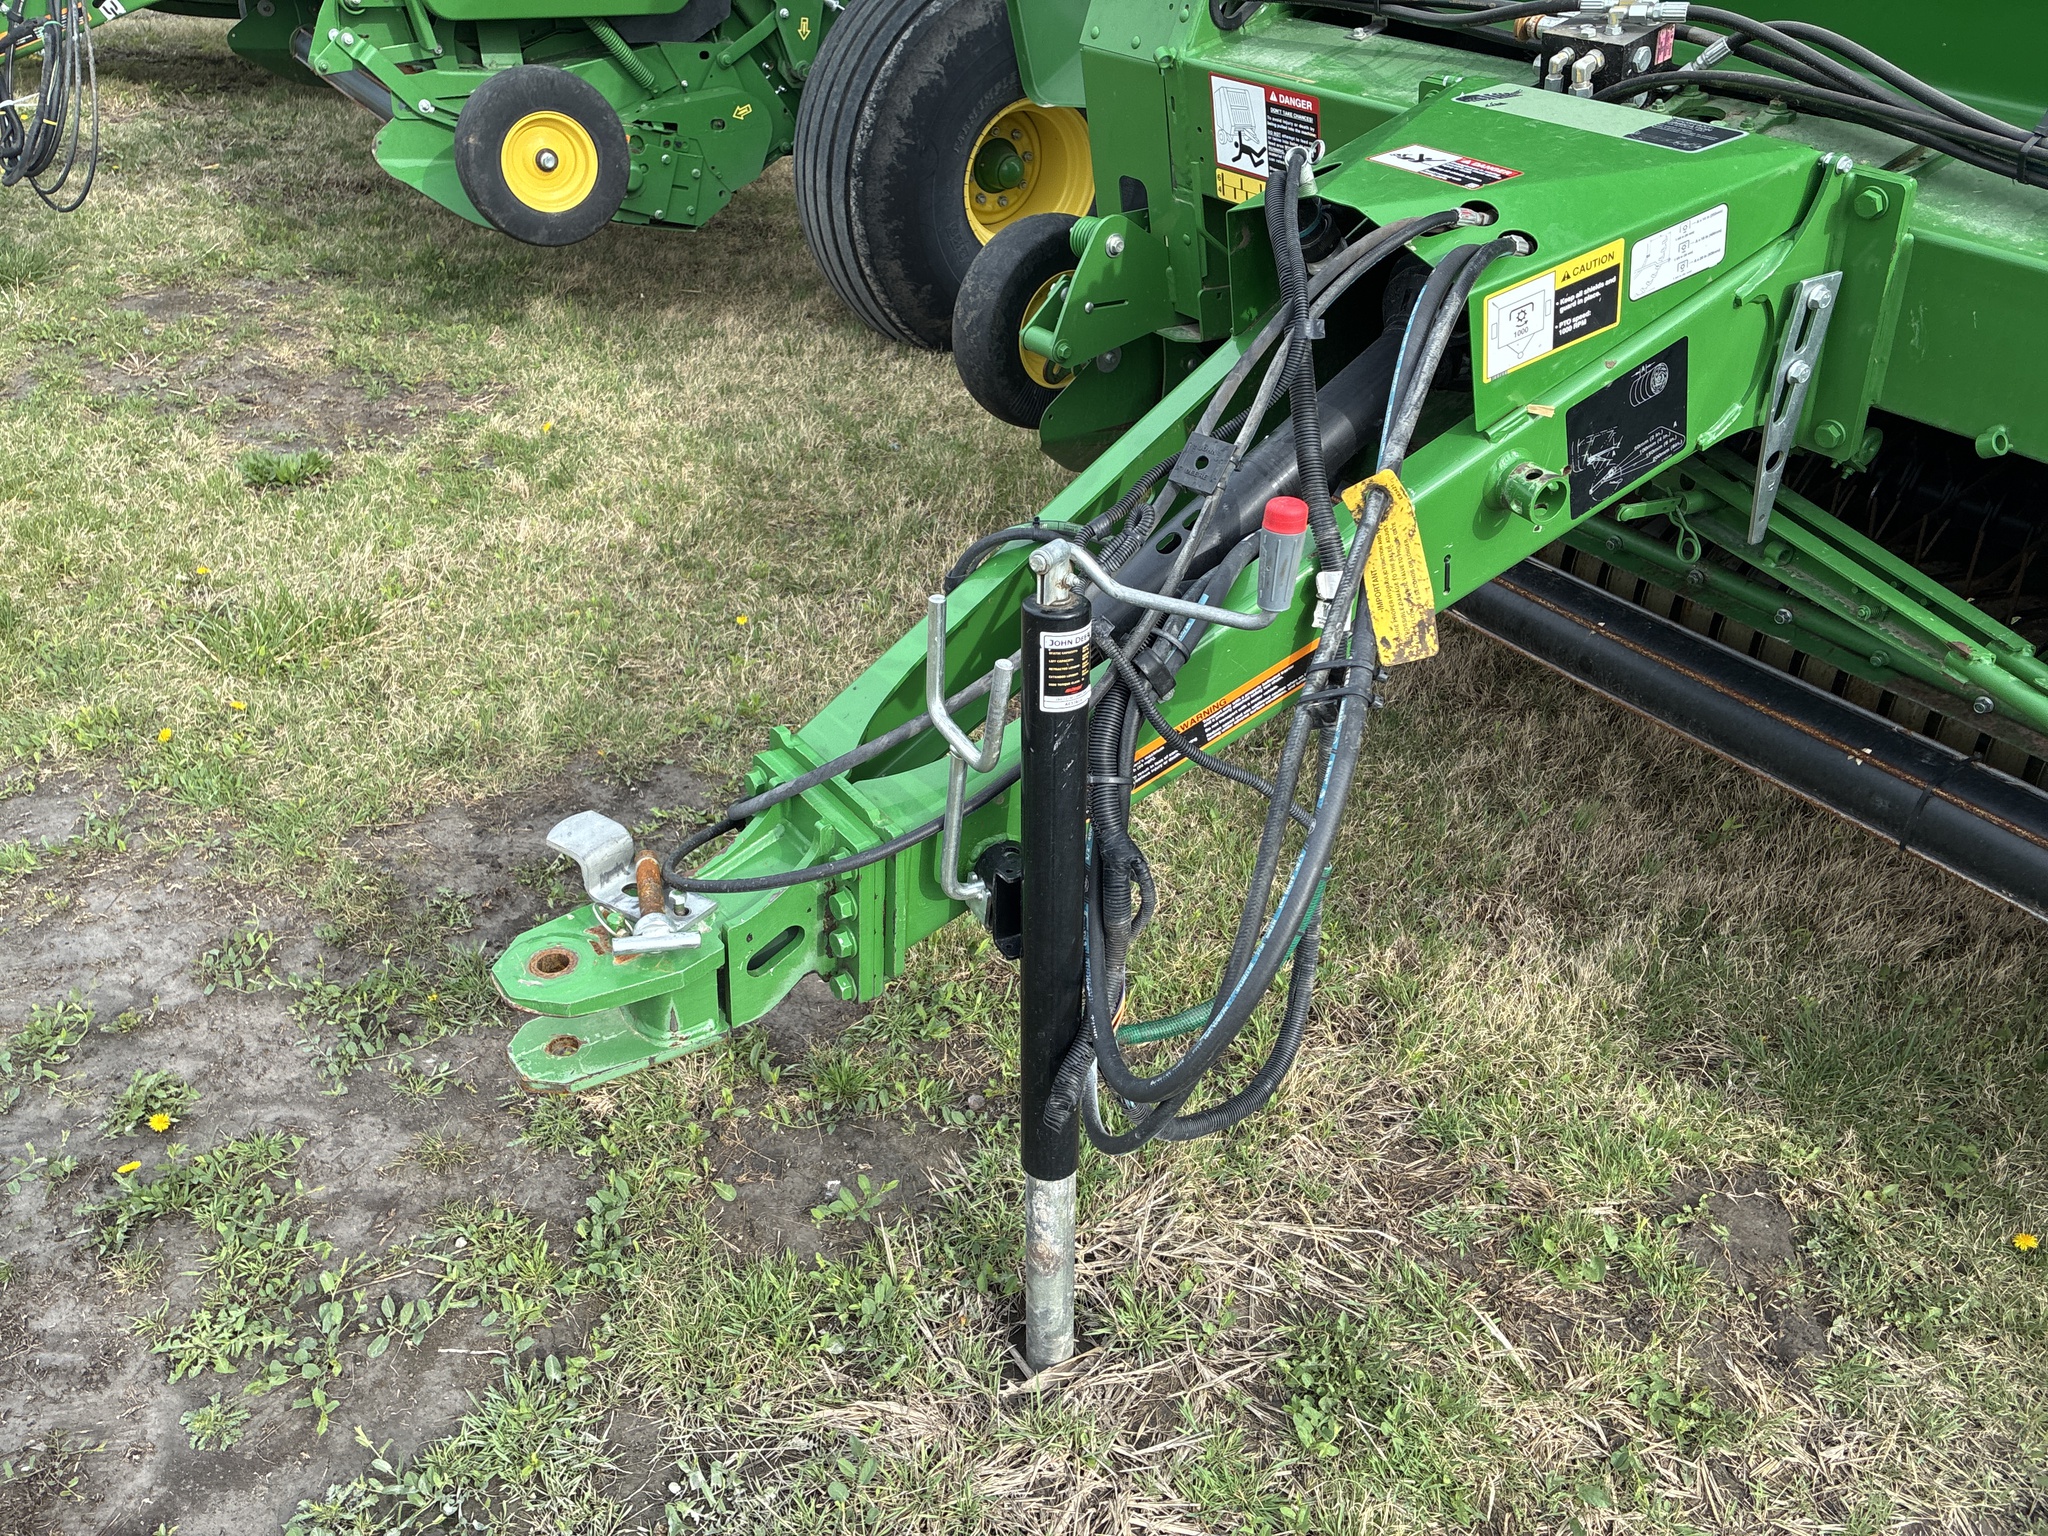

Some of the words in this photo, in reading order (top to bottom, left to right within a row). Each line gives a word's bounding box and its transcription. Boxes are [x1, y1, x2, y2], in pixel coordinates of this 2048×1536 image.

[1278, 93, 1312, 110] DANGER
[1572, 251, 1615, 276] CAUTION
[1559, 293, 1574, 305] Keep
[1583, 280, 1604, 295] shields
[1605, 275, 1616, 285] and
[1559, 300, 1576, 314] guard
[1577, 297, 1582, 305] in
[1558, 317, 1570, 328] PTO
[1572, 309, 1591, 324] speed:
[1558, 324, 1571, 335] 1000
[1573, 318, 1586, 329] RPM
[1514, 326, 1529, 338] 1000
[1379, 545, 1388, 569] FUNCTION
[1400, 564, 1408, 581] VALVE
[1394, 581, 1404, 606] DAMAGE
[1389, 599, 1398, 622] PROPER
[1049, 639, 1073, 647] JOHN
[1179, 699, 1227, 732] WARNING
[1218, 709, 1237, 723] transport
[1237, 703, 1247, 712] with
[1250, 694, 1262, 704] motor
